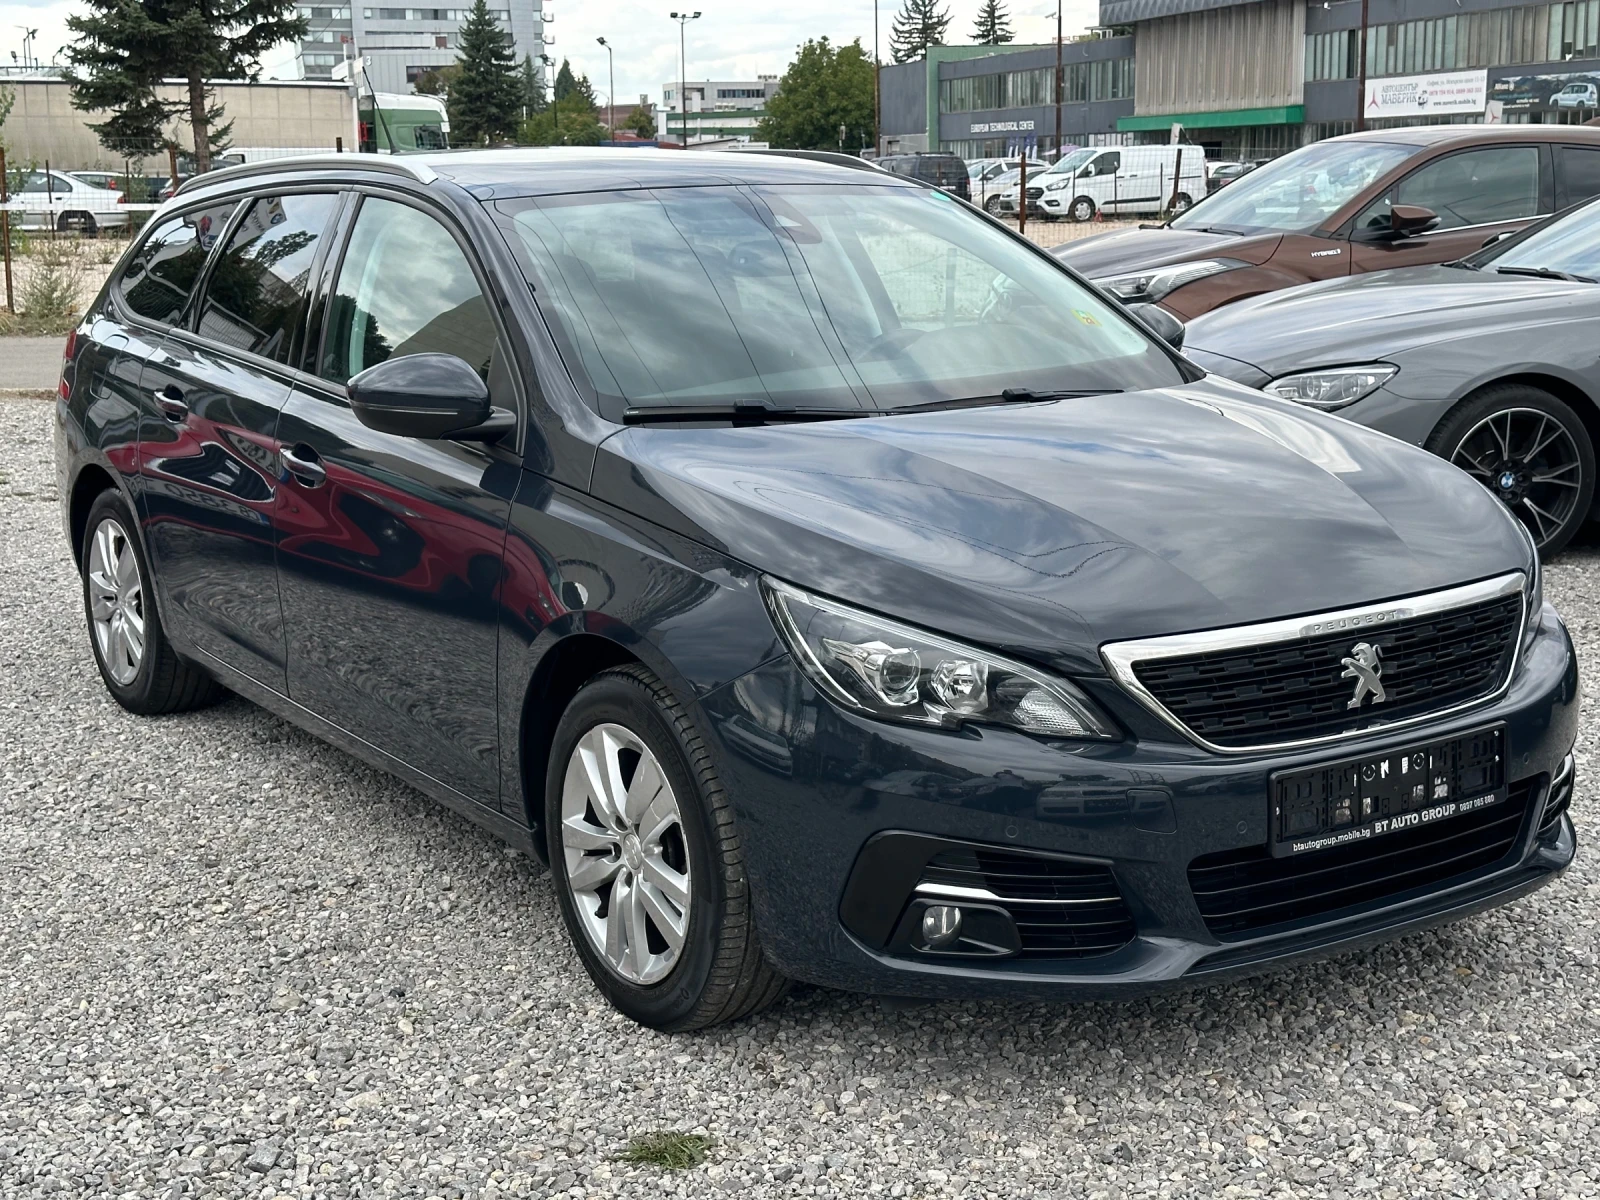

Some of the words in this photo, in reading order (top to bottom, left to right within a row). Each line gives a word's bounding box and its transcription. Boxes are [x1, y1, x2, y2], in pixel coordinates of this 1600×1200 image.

[1381, 83, 1418, 94] АВТОЦЕНТЪР
[1381, 92, 1418, 105] МАВЕРИК
[1019, 120, 1035, 130] CENTER
[1314, 610, 1397, 633] PEUGEOT
[1293, 828, 1371, 852] btautogroup.mobile.bg
[1374, 820, 1389, 833] BT
[1391, 813, 1419, 829] AUTO
[1421, 803, 1456, 822] GROUP
